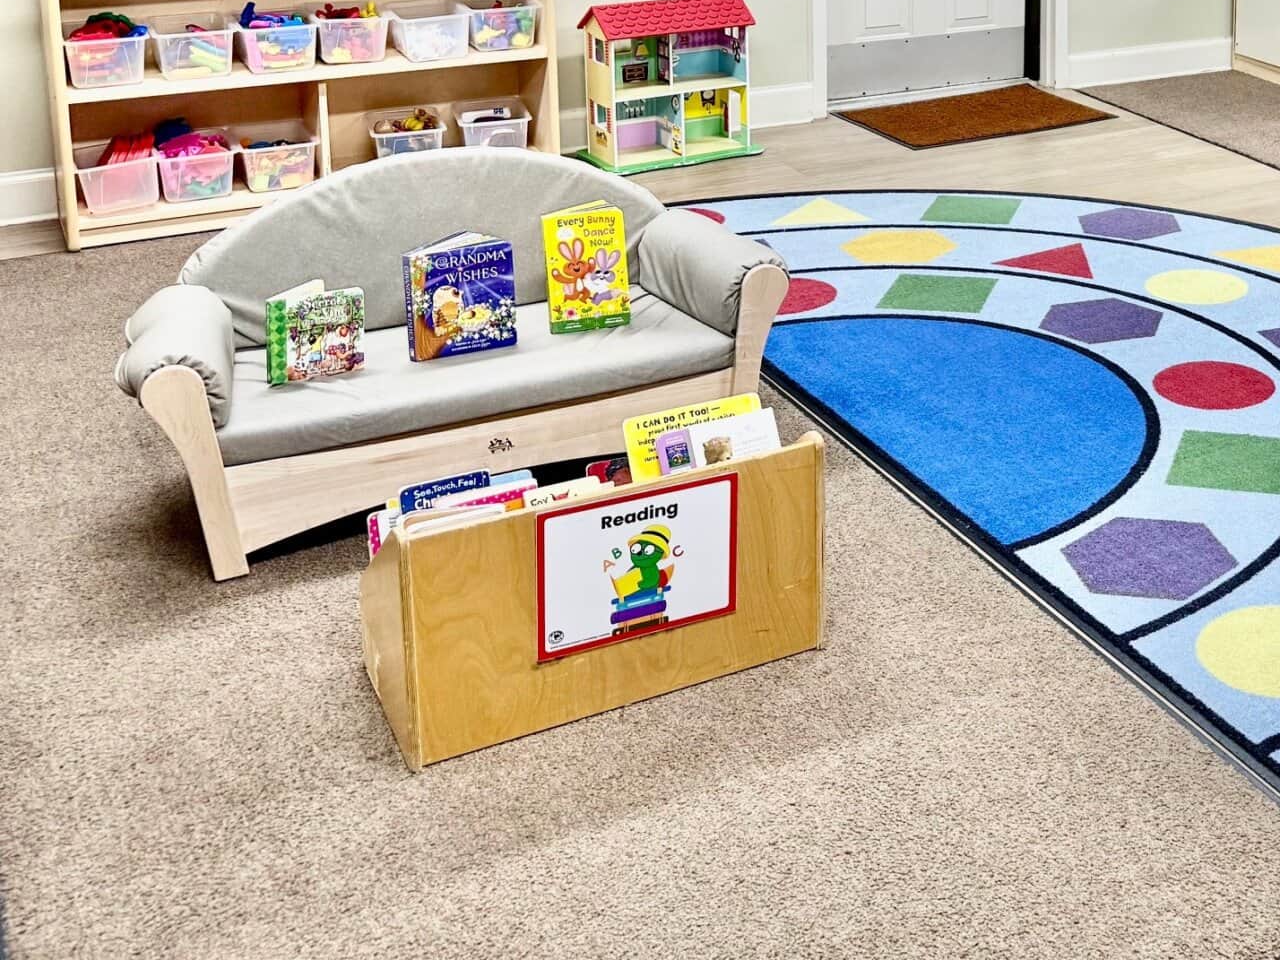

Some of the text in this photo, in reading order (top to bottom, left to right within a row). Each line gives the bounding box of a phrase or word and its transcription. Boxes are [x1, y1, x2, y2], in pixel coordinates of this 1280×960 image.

[557, 215, 616, 228] Every Bunny
[583, 227, 615, 238] Dance
[445, 266, 499, 285] WISHES
[643, 418, 661, 428] CAN
[664, 415, 675, 424] DO
[678, 412, 687, 420] IT
[689, 407, 709, 418] TOO!
[457, 477, 476, 487] Feel
[601, 503, 678, 530] Reading
[612, 547, 622, 560] B
[672, 545, 684, 558] C
